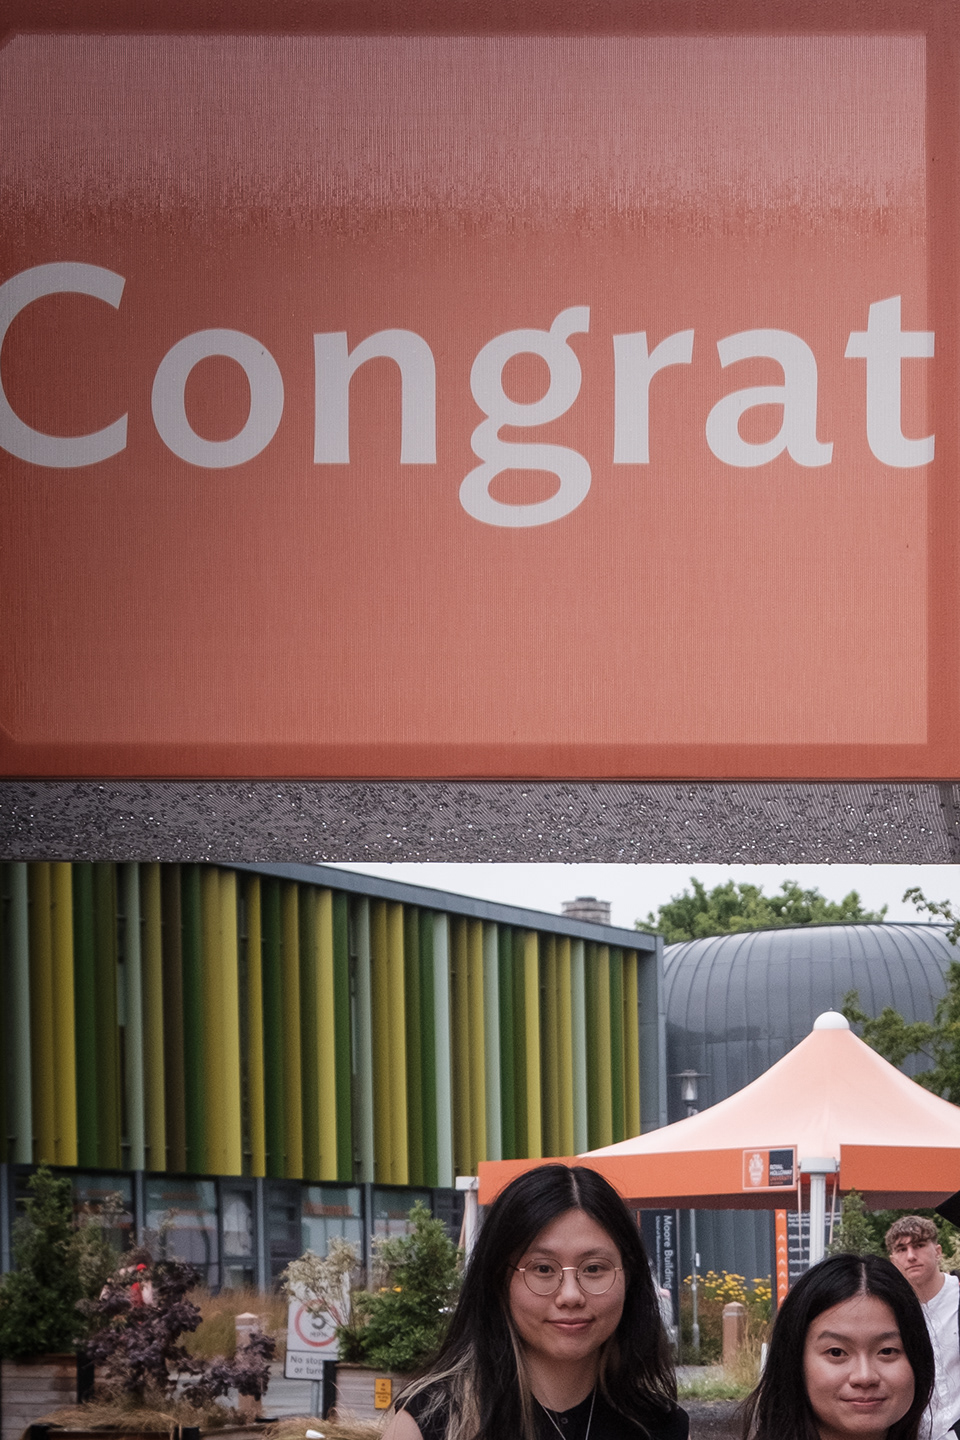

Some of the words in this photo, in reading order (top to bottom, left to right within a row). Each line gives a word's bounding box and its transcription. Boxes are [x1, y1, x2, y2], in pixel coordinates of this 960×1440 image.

[663, 1215, 673, 1248] Moore
[662, 1249, 674, 1289] Building
[290, 1355, 303, 1364] No
